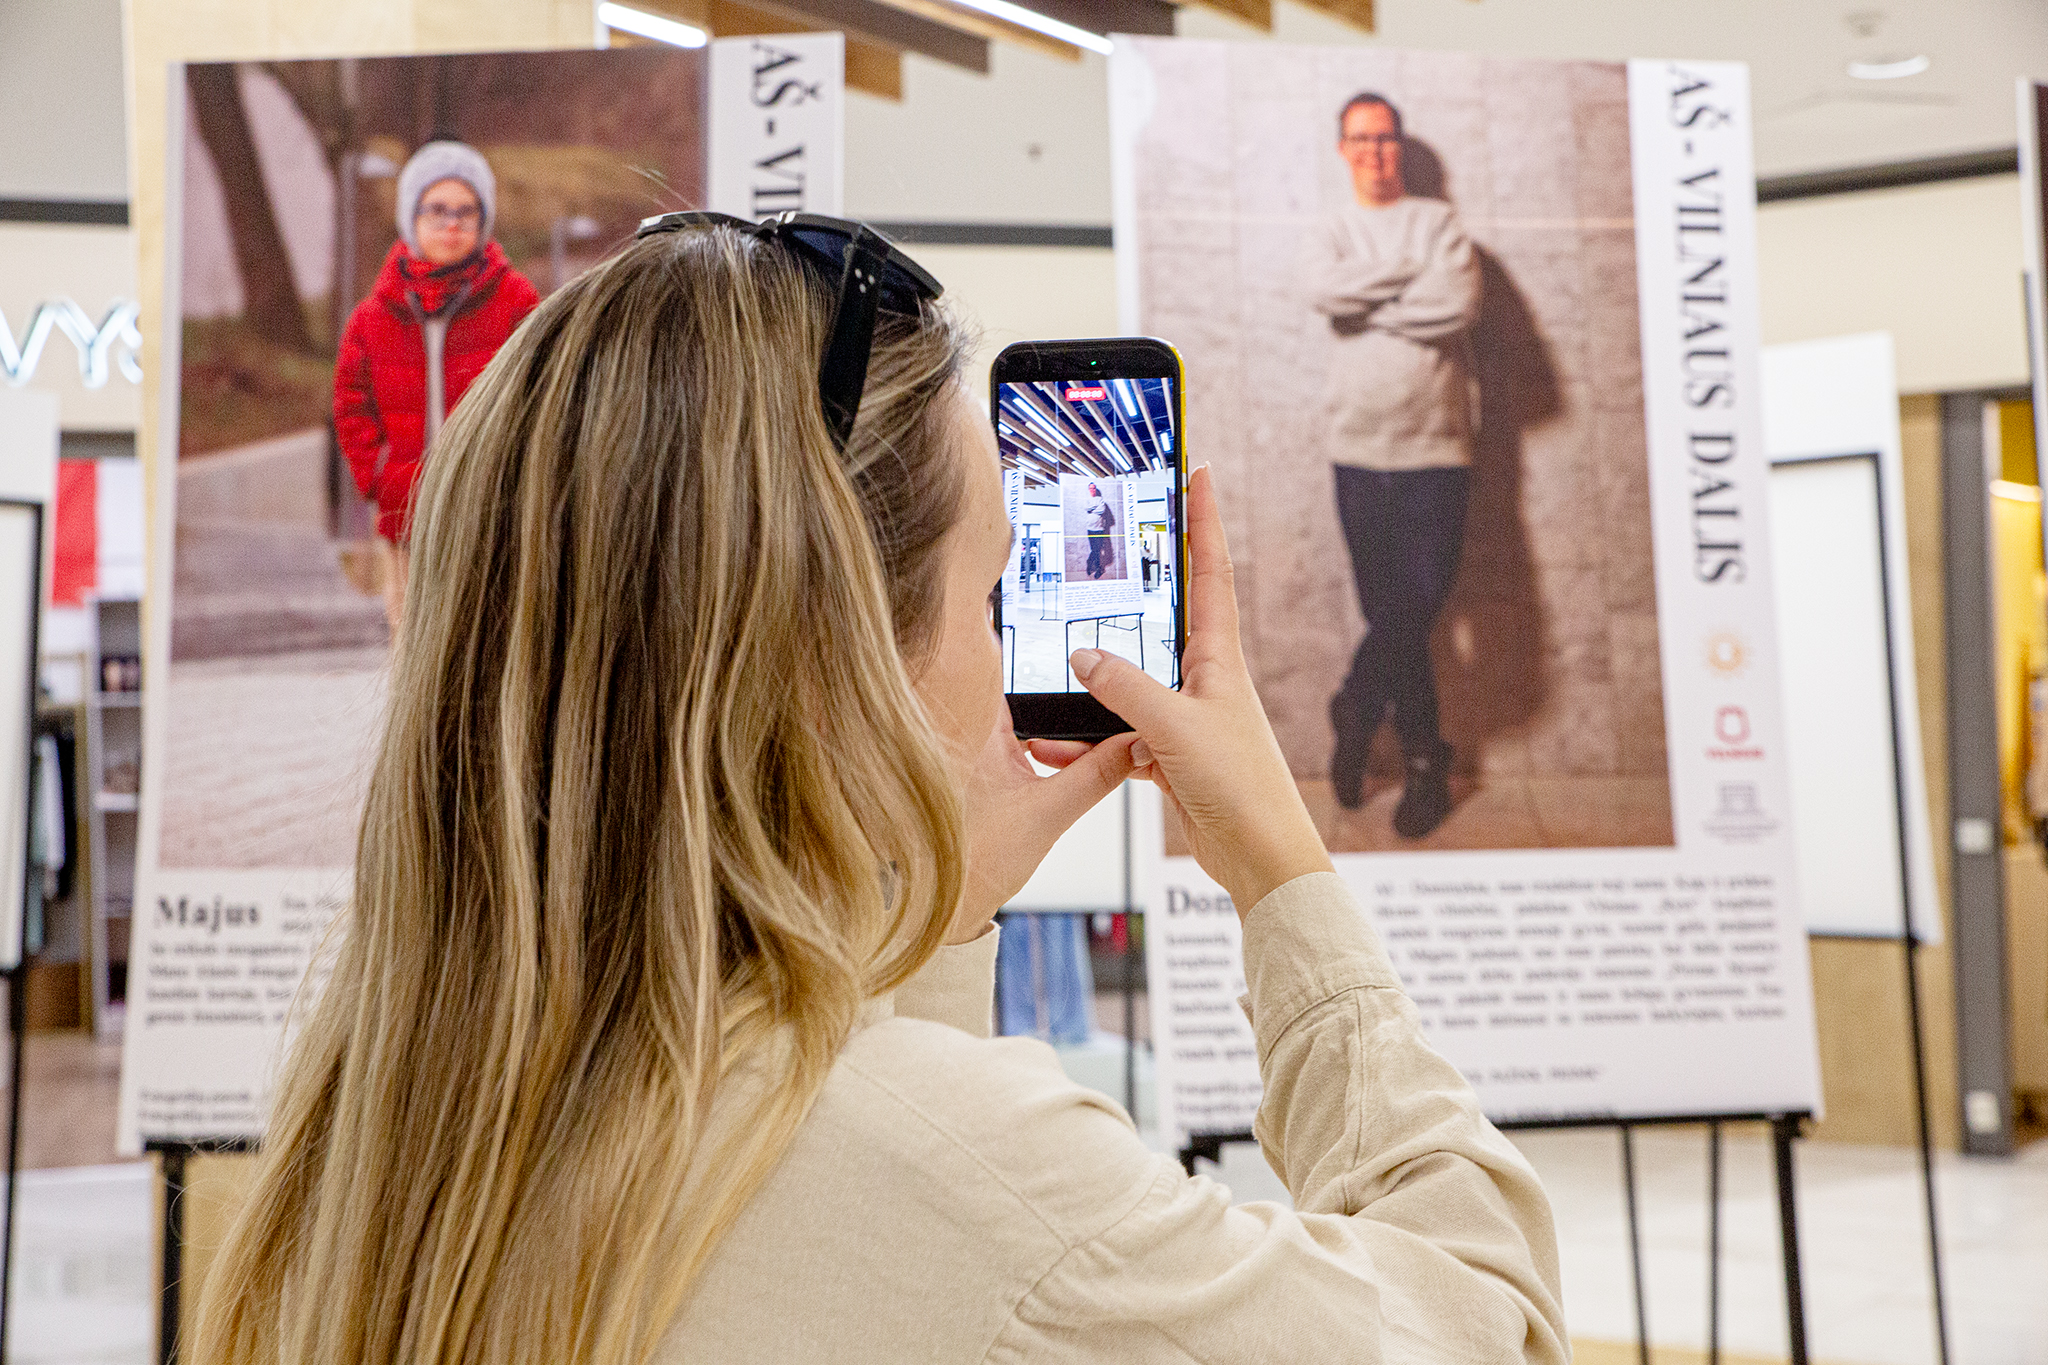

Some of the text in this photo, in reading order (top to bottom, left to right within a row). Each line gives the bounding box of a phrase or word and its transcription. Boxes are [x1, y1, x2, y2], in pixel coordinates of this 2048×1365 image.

[754, 40, 821, 108] AŠ
[1667, 62, 1733, 129] AŠ
[1676, 168, 1736, 409] VILNIAUS
[1688, 431, 1747, 585] DALIS
[155, 895, 260, 935] Majus
